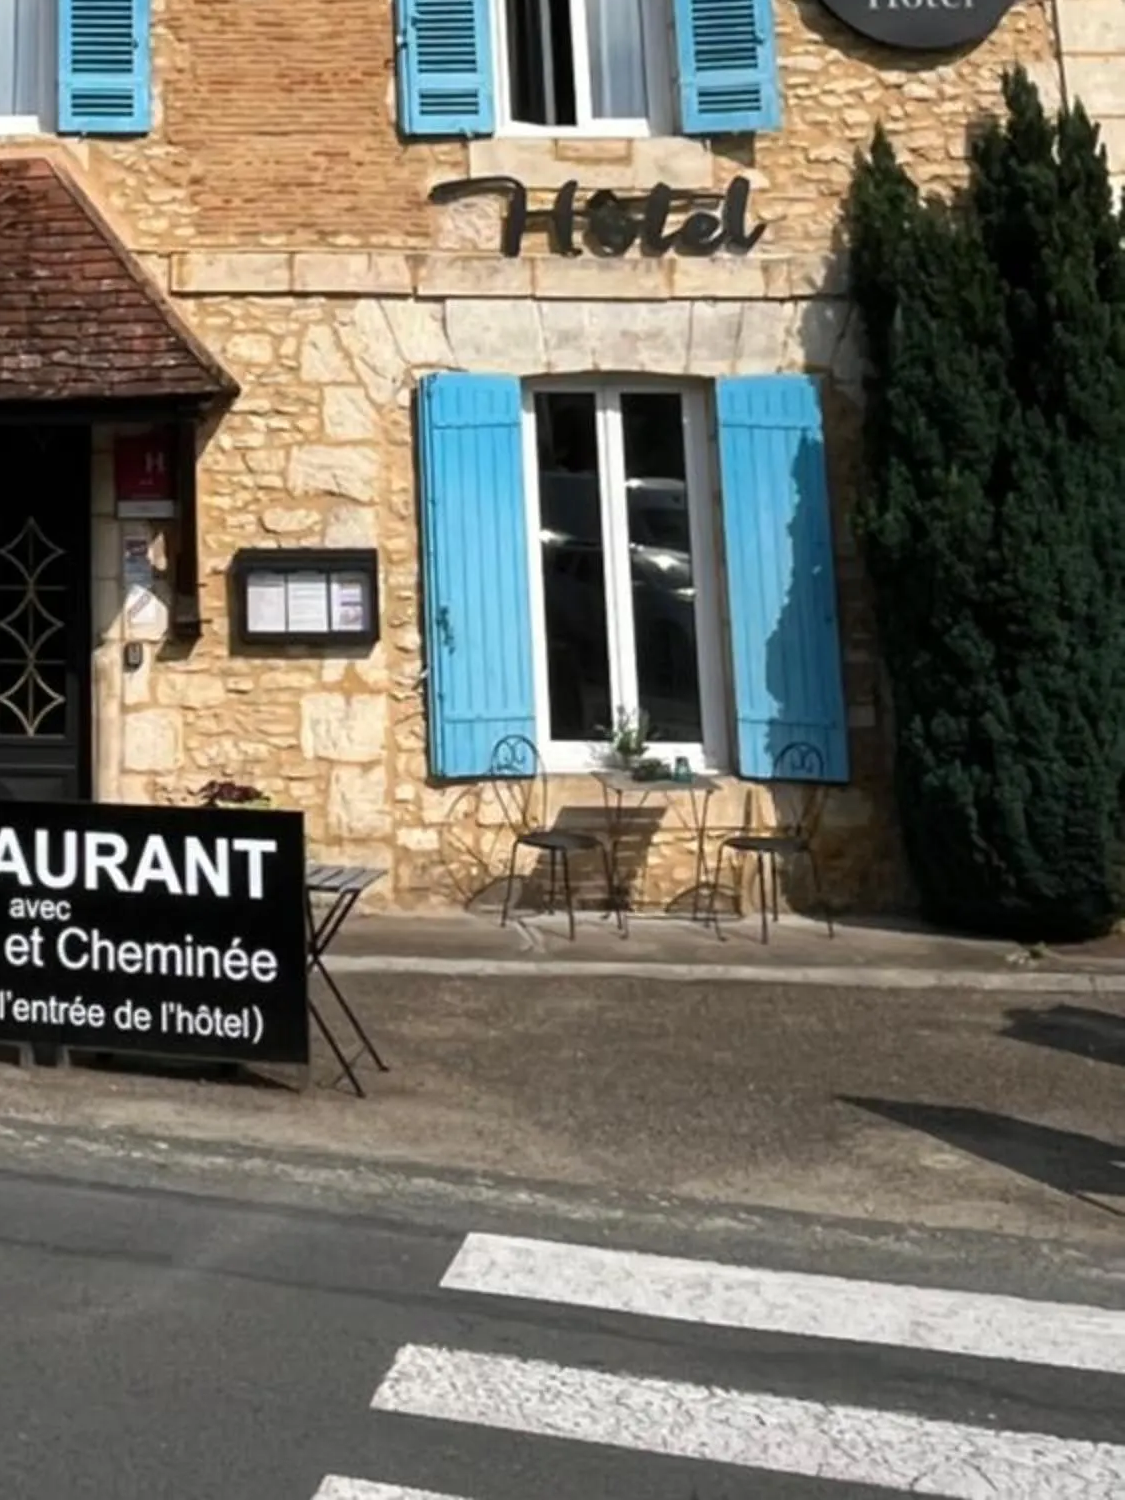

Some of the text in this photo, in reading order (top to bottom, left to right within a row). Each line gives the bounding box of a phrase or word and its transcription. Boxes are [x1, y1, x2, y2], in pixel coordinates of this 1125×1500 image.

[9, 897, 72, 921] avec
[4, 928, 43, 967] et
[57, 927, 279, 982] Cheminée
[115, 1005, 152, 1030] de
[161, 1005, 264, 1043] l'hôtel)
